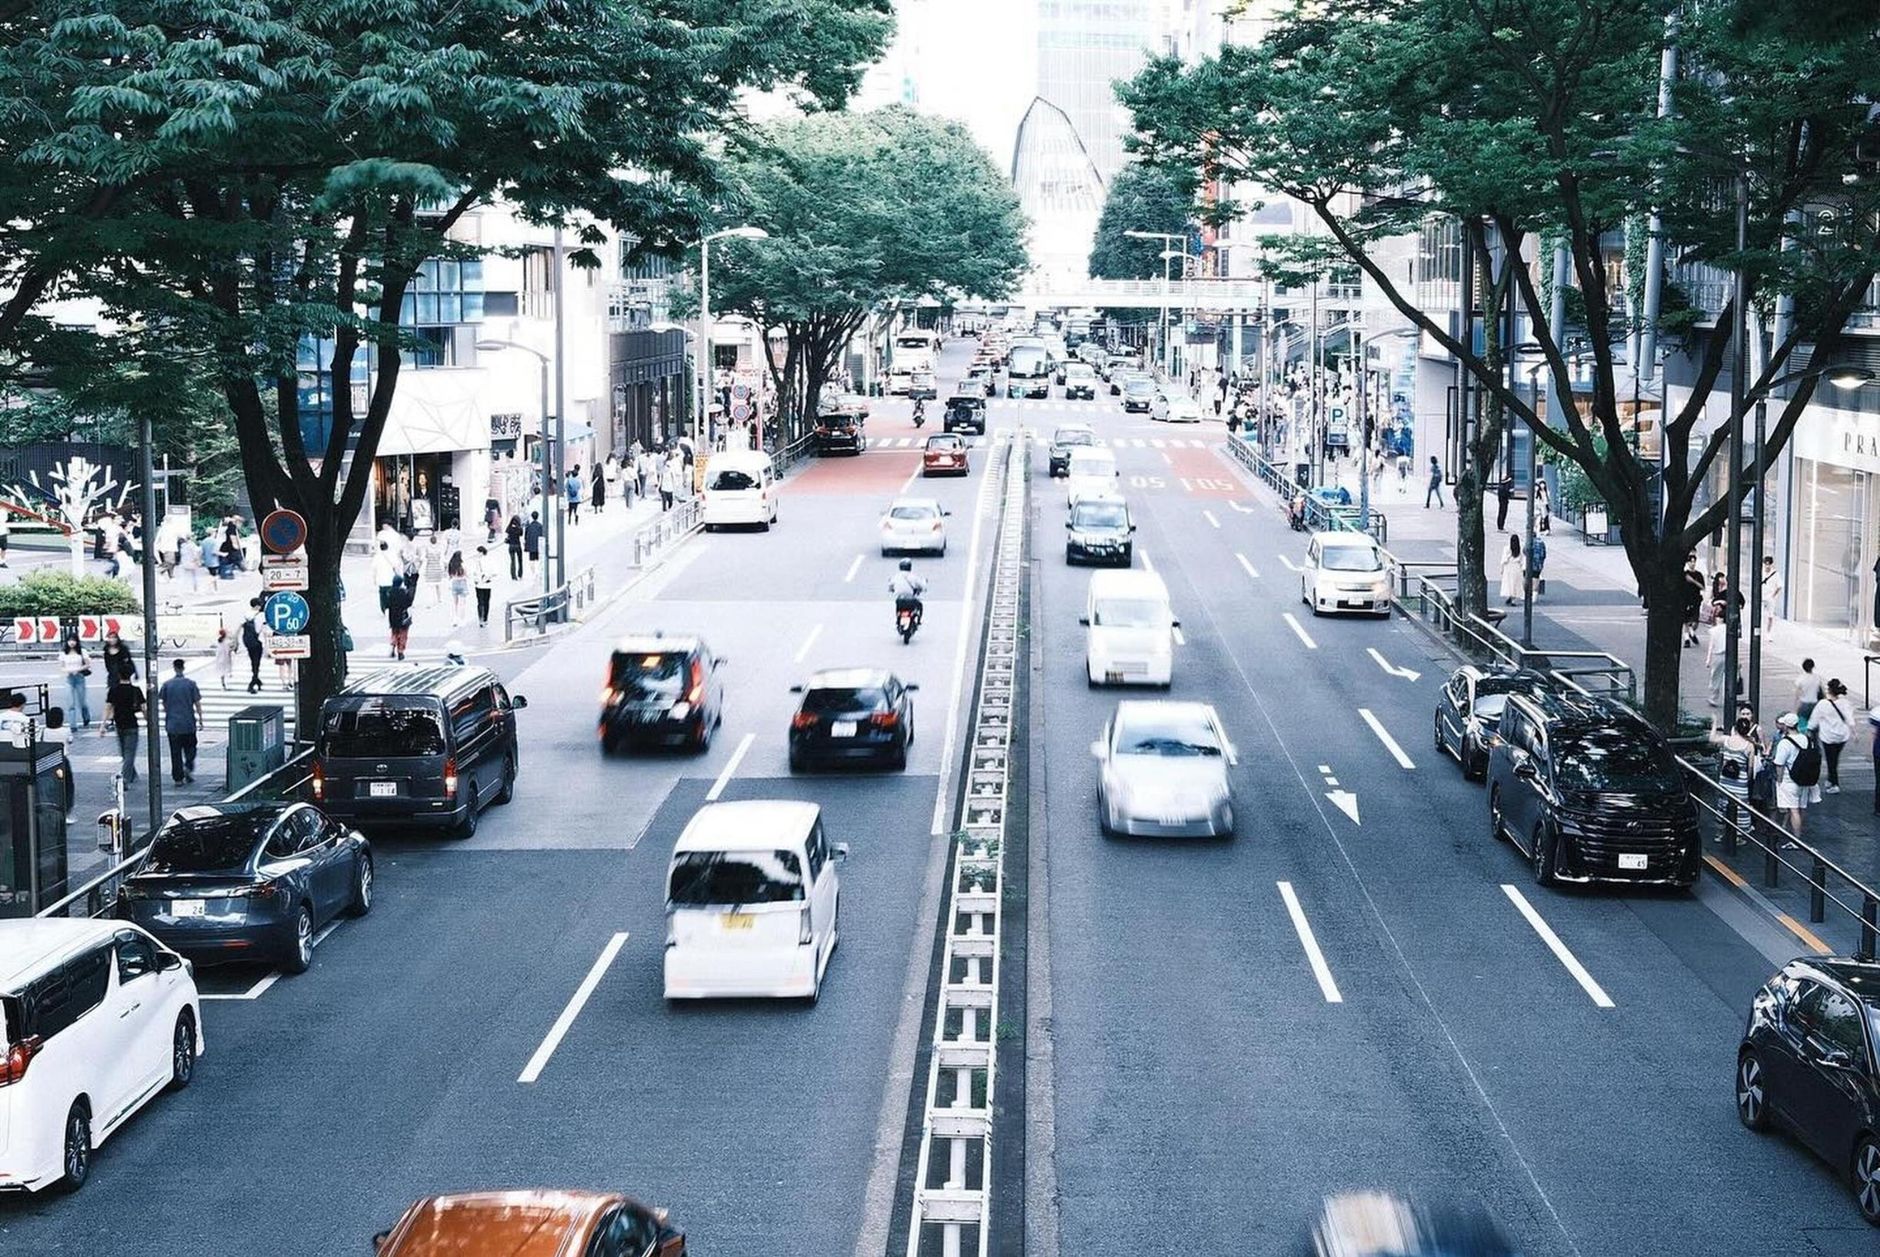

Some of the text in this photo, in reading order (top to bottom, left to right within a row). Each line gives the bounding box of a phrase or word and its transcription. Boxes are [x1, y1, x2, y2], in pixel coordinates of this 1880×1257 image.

[1332, 408, 1344, 423] P
[274, 603, 291, 630] P
[286, 618, 299, 630] 60
